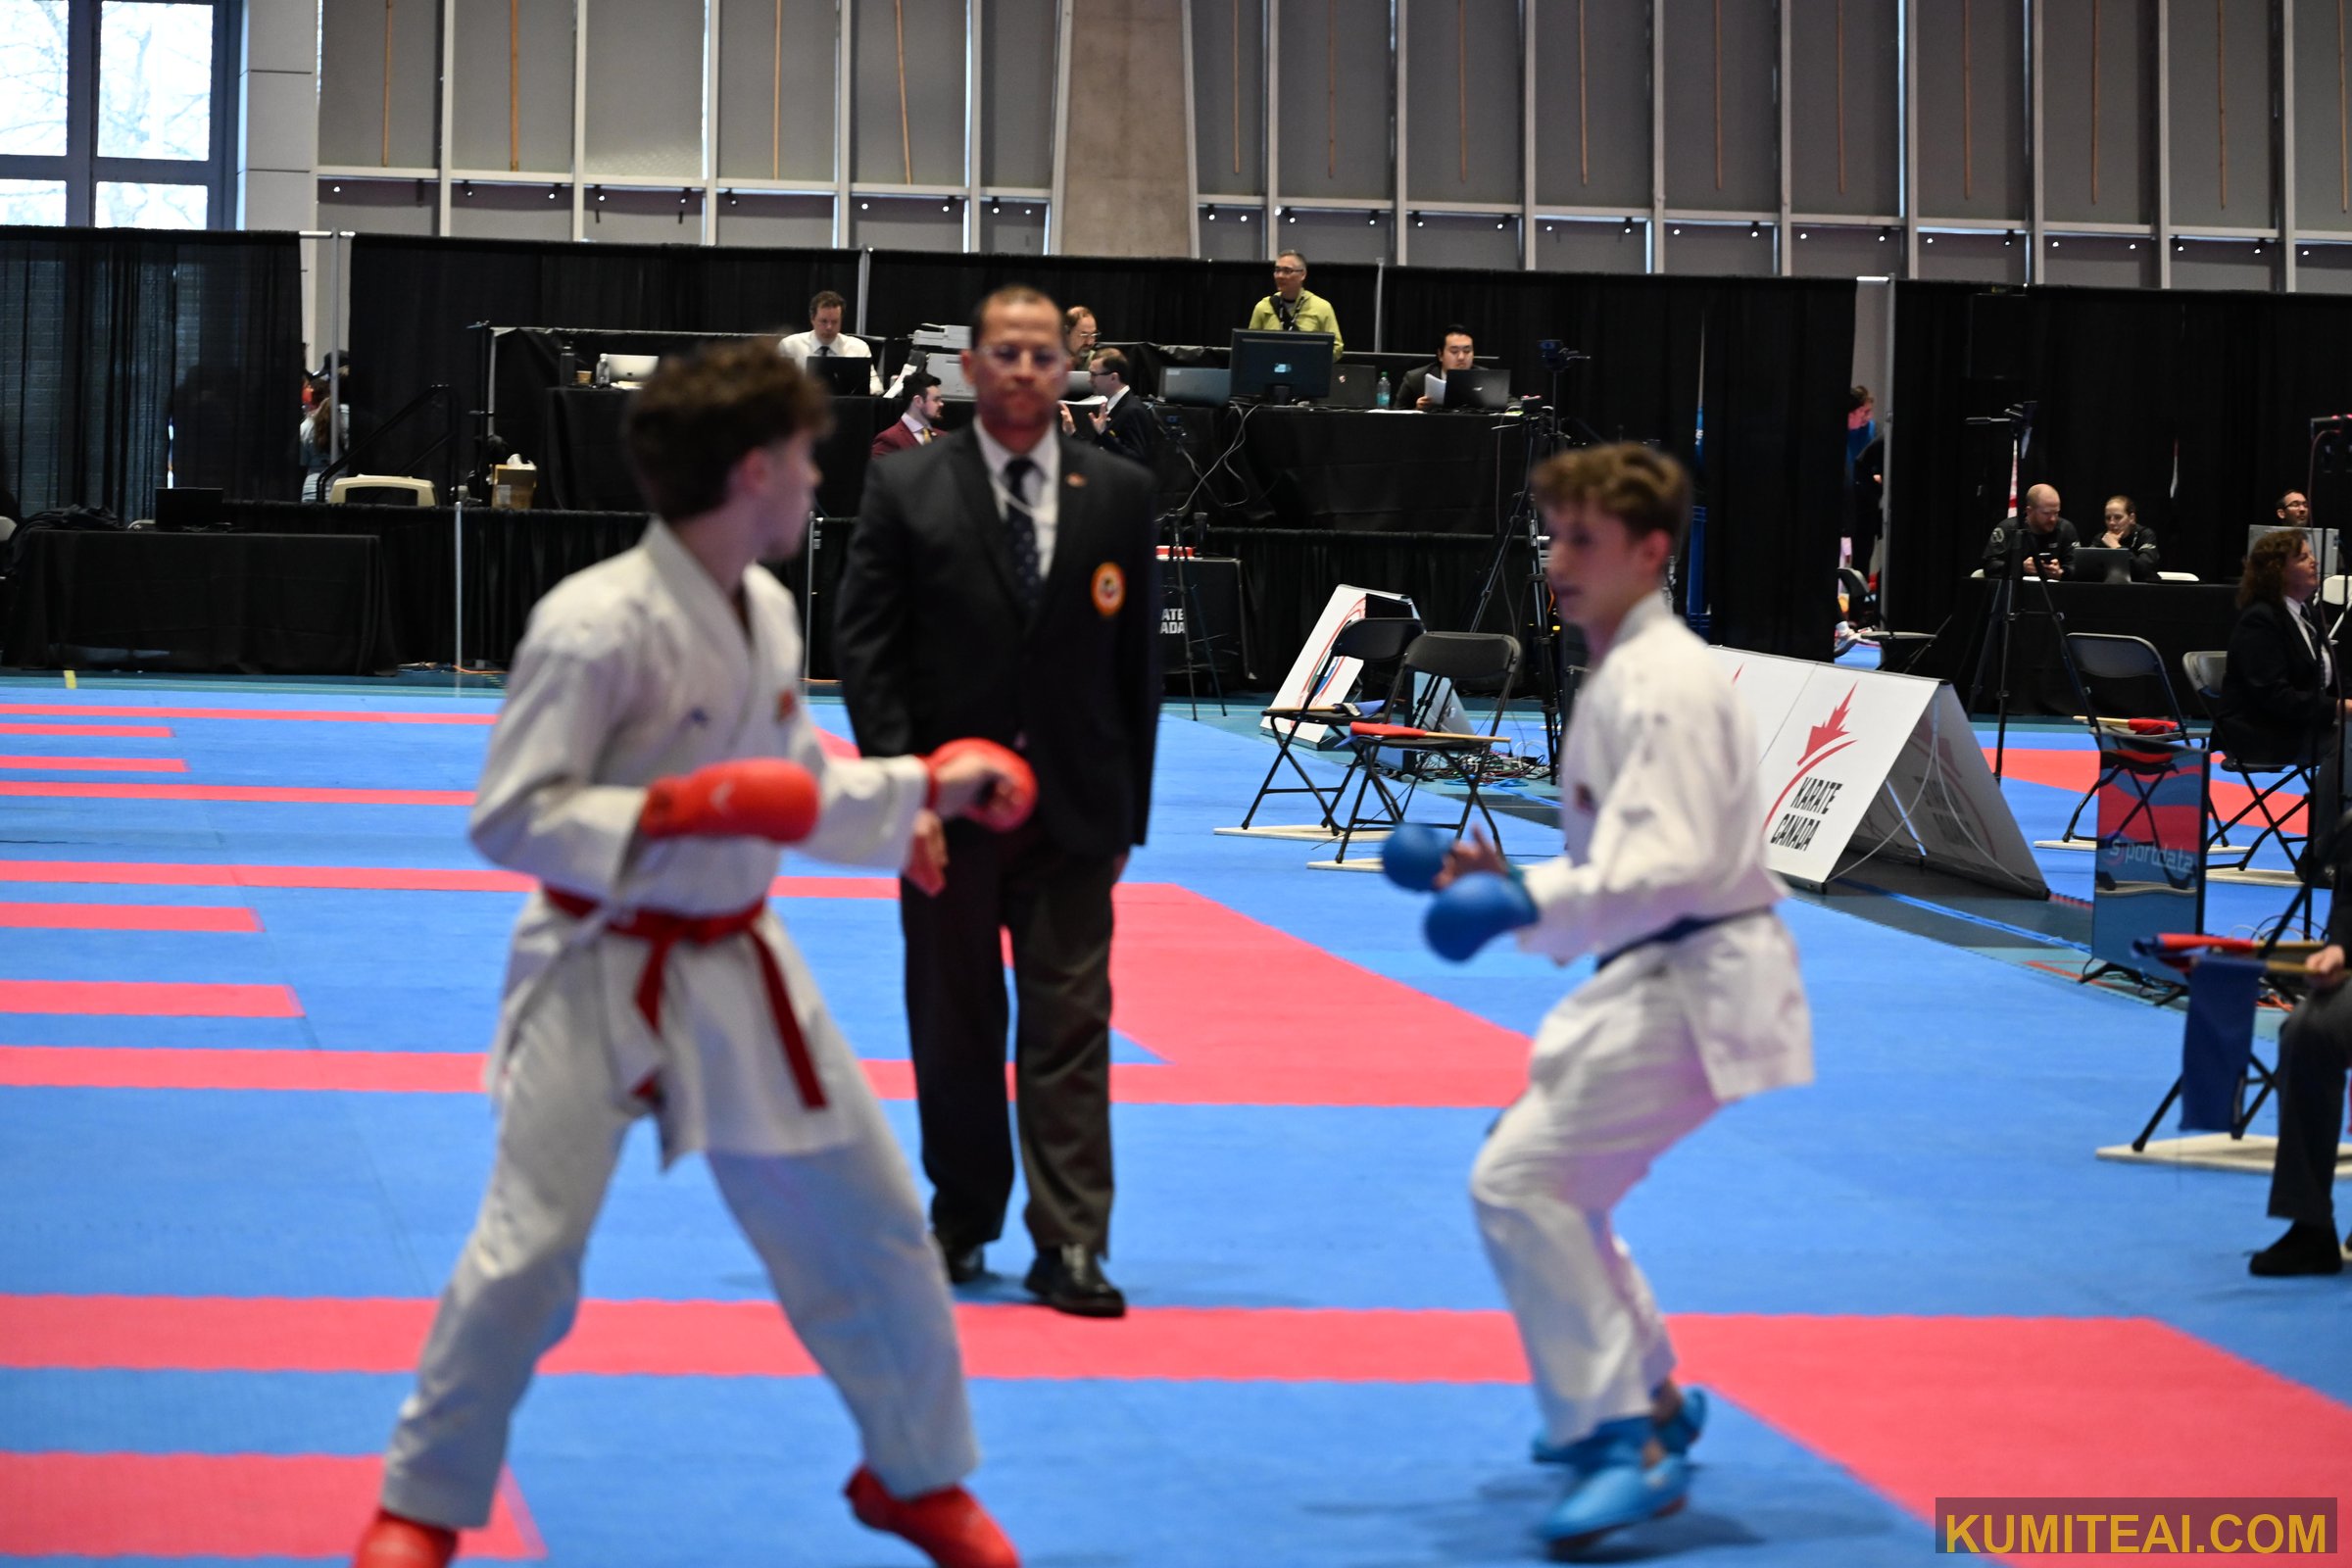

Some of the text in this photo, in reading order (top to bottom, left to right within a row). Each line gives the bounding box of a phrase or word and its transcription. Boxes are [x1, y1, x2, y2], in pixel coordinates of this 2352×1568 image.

[1160, 608, 1185, 621] ATE
[1159, 621, 1186, 634] ADA
[1790, 776, 1843, 814] KARATE
[1770, 813, 1821, 852] CANADA
